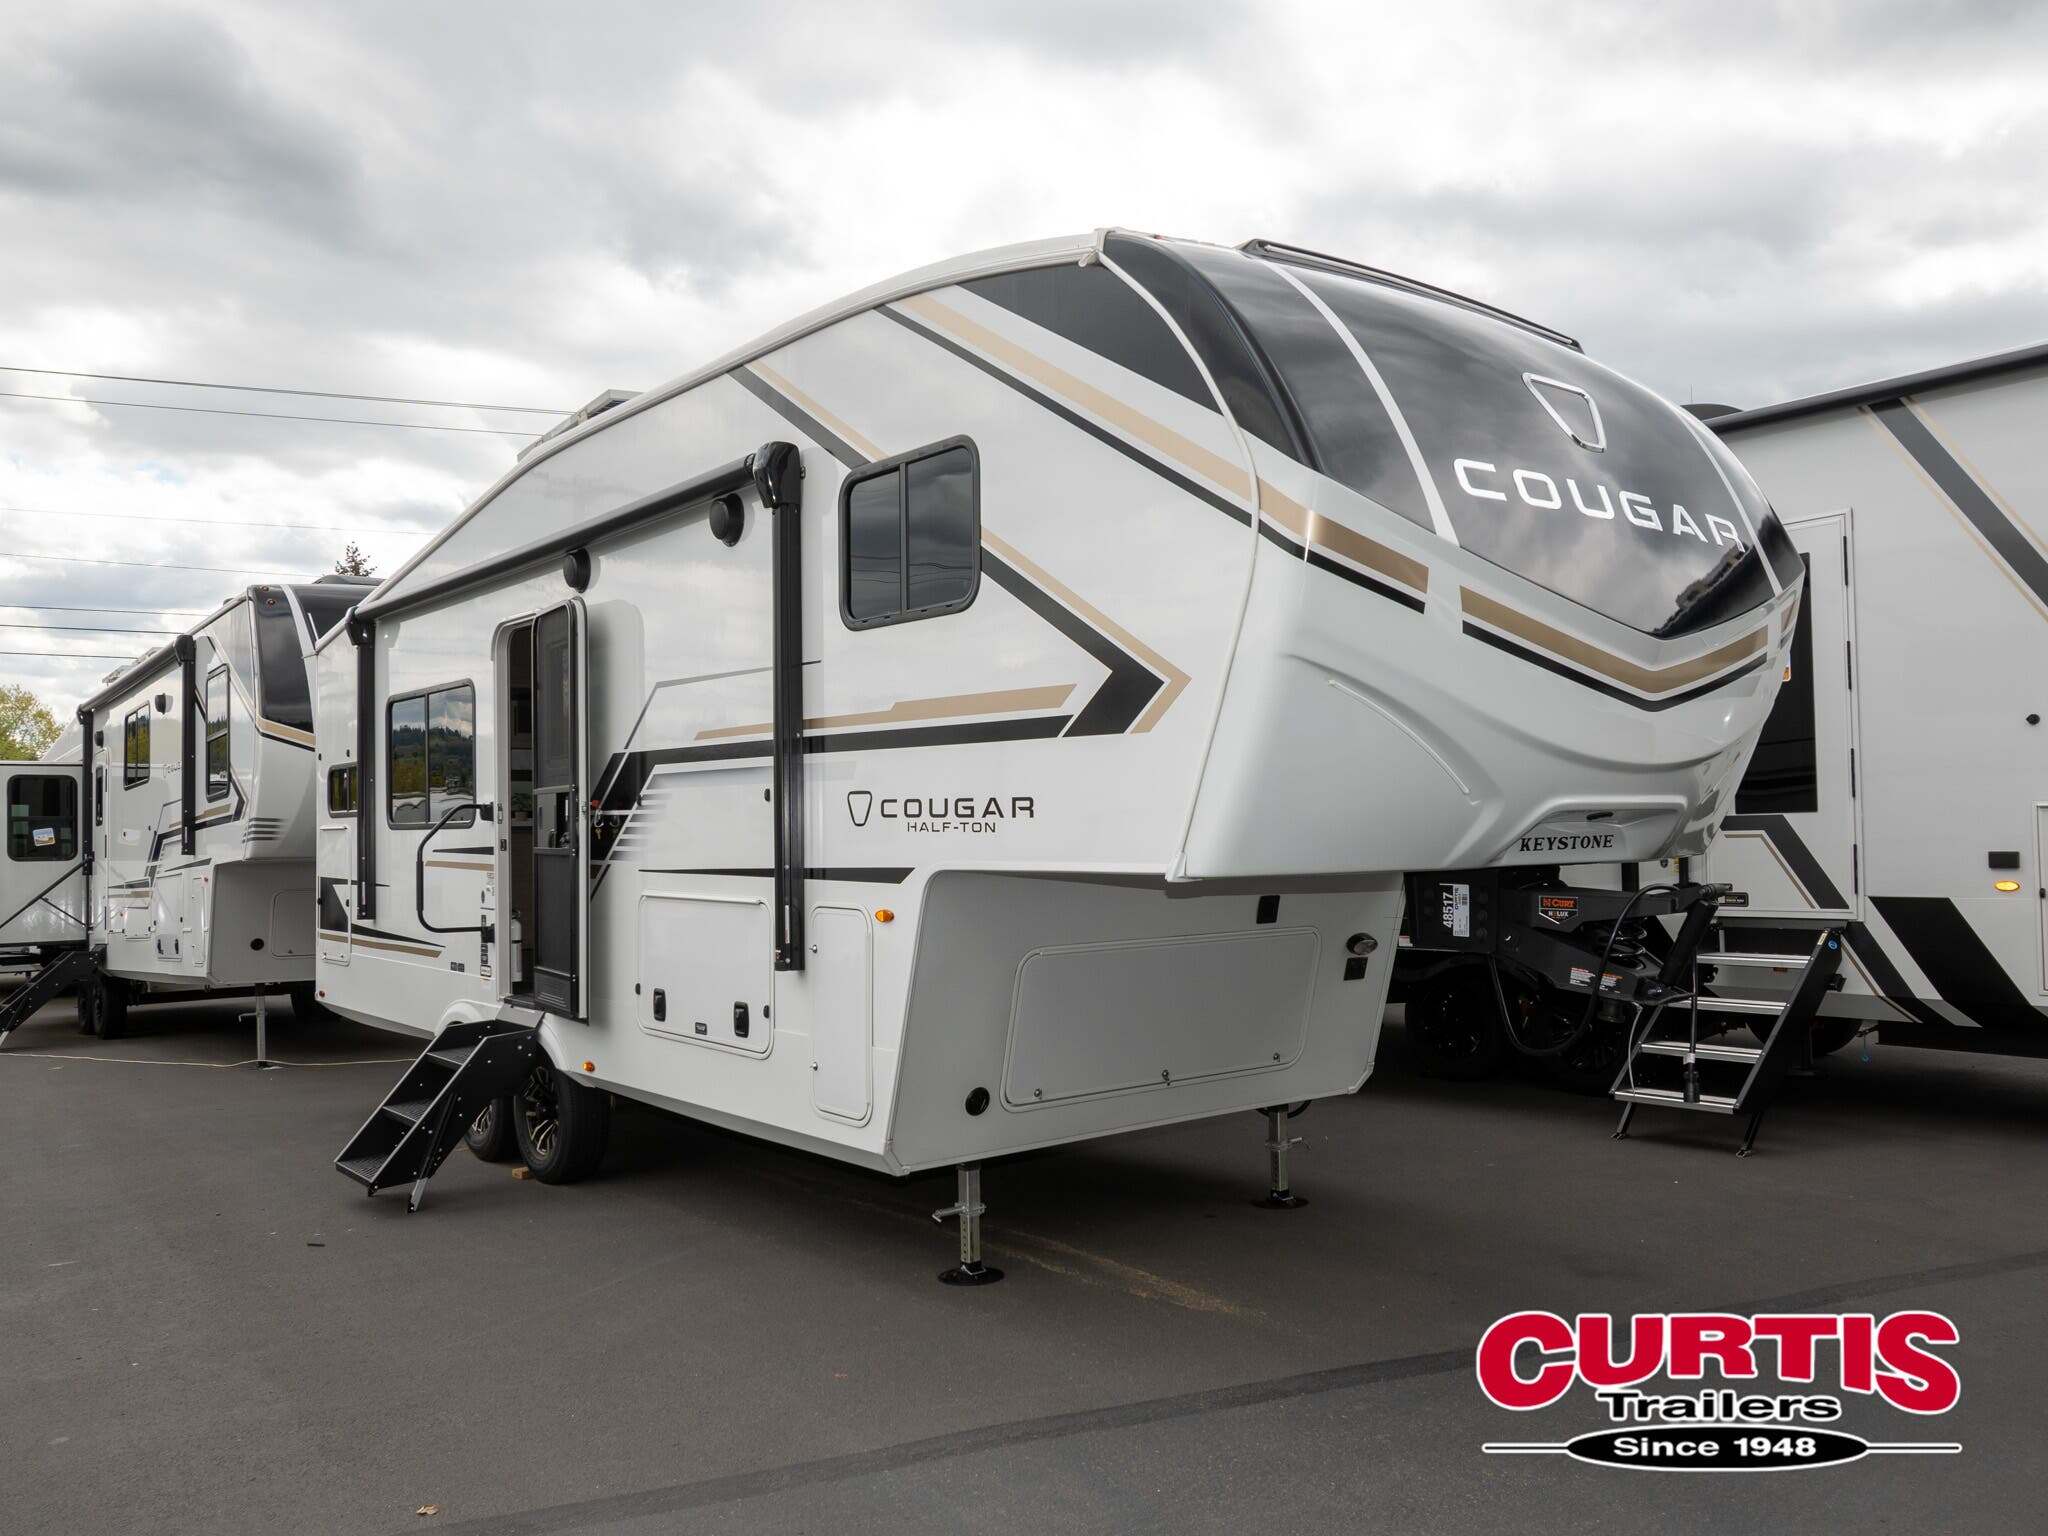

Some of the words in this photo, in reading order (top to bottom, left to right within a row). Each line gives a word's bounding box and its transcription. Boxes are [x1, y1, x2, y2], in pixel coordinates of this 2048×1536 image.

[1453, 458, 1745, 552] COUGAR
[881, 797, 1034, 818] COUGAR
[907, 822, 996, 833] HALF-TON
[1520, 834, 1614, 851] KEYSTONE
[1442, 892, 1453, 928] 48517
